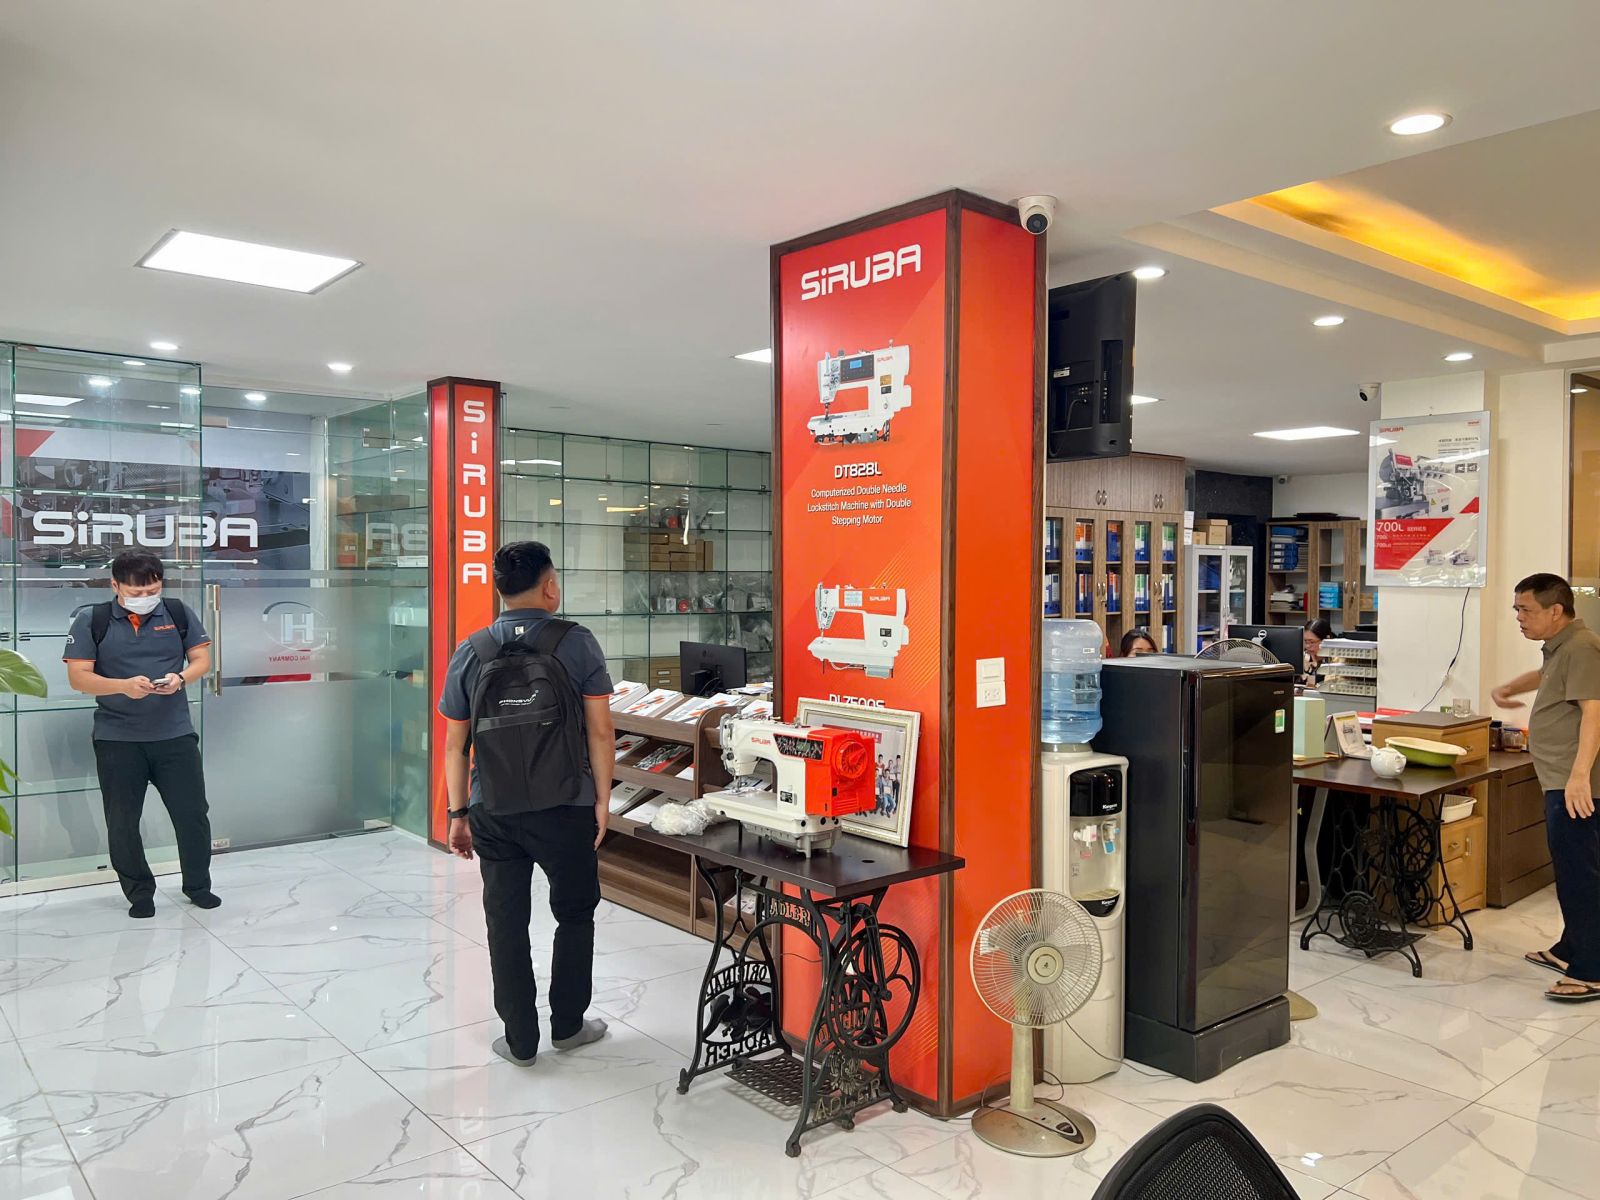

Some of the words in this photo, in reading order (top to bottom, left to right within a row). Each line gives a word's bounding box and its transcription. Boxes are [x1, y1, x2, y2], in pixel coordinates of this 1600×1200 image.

[801, 243, 921, 301] SiRUBA
[834, 461, 883, 479] DT828L
[811, 486, 856, 498] Computerized
[856, 485, 881, 495] Double
[882, 483, 907, 493] Needle
[807, 502, 839, 513] Lockstitch
[840, 500, 869, 511] Machine
[870, 499, 885, 509] with
[886, 498, 912, 508] Double
[832, 515, 861, 526] Stepping
[862, 514, 883, 524] Motor
[1376, 521, 1404, 532] 700L
[33, 510, 259, 548] SiRUBA
[769, 897, 810, 928] ADLER
